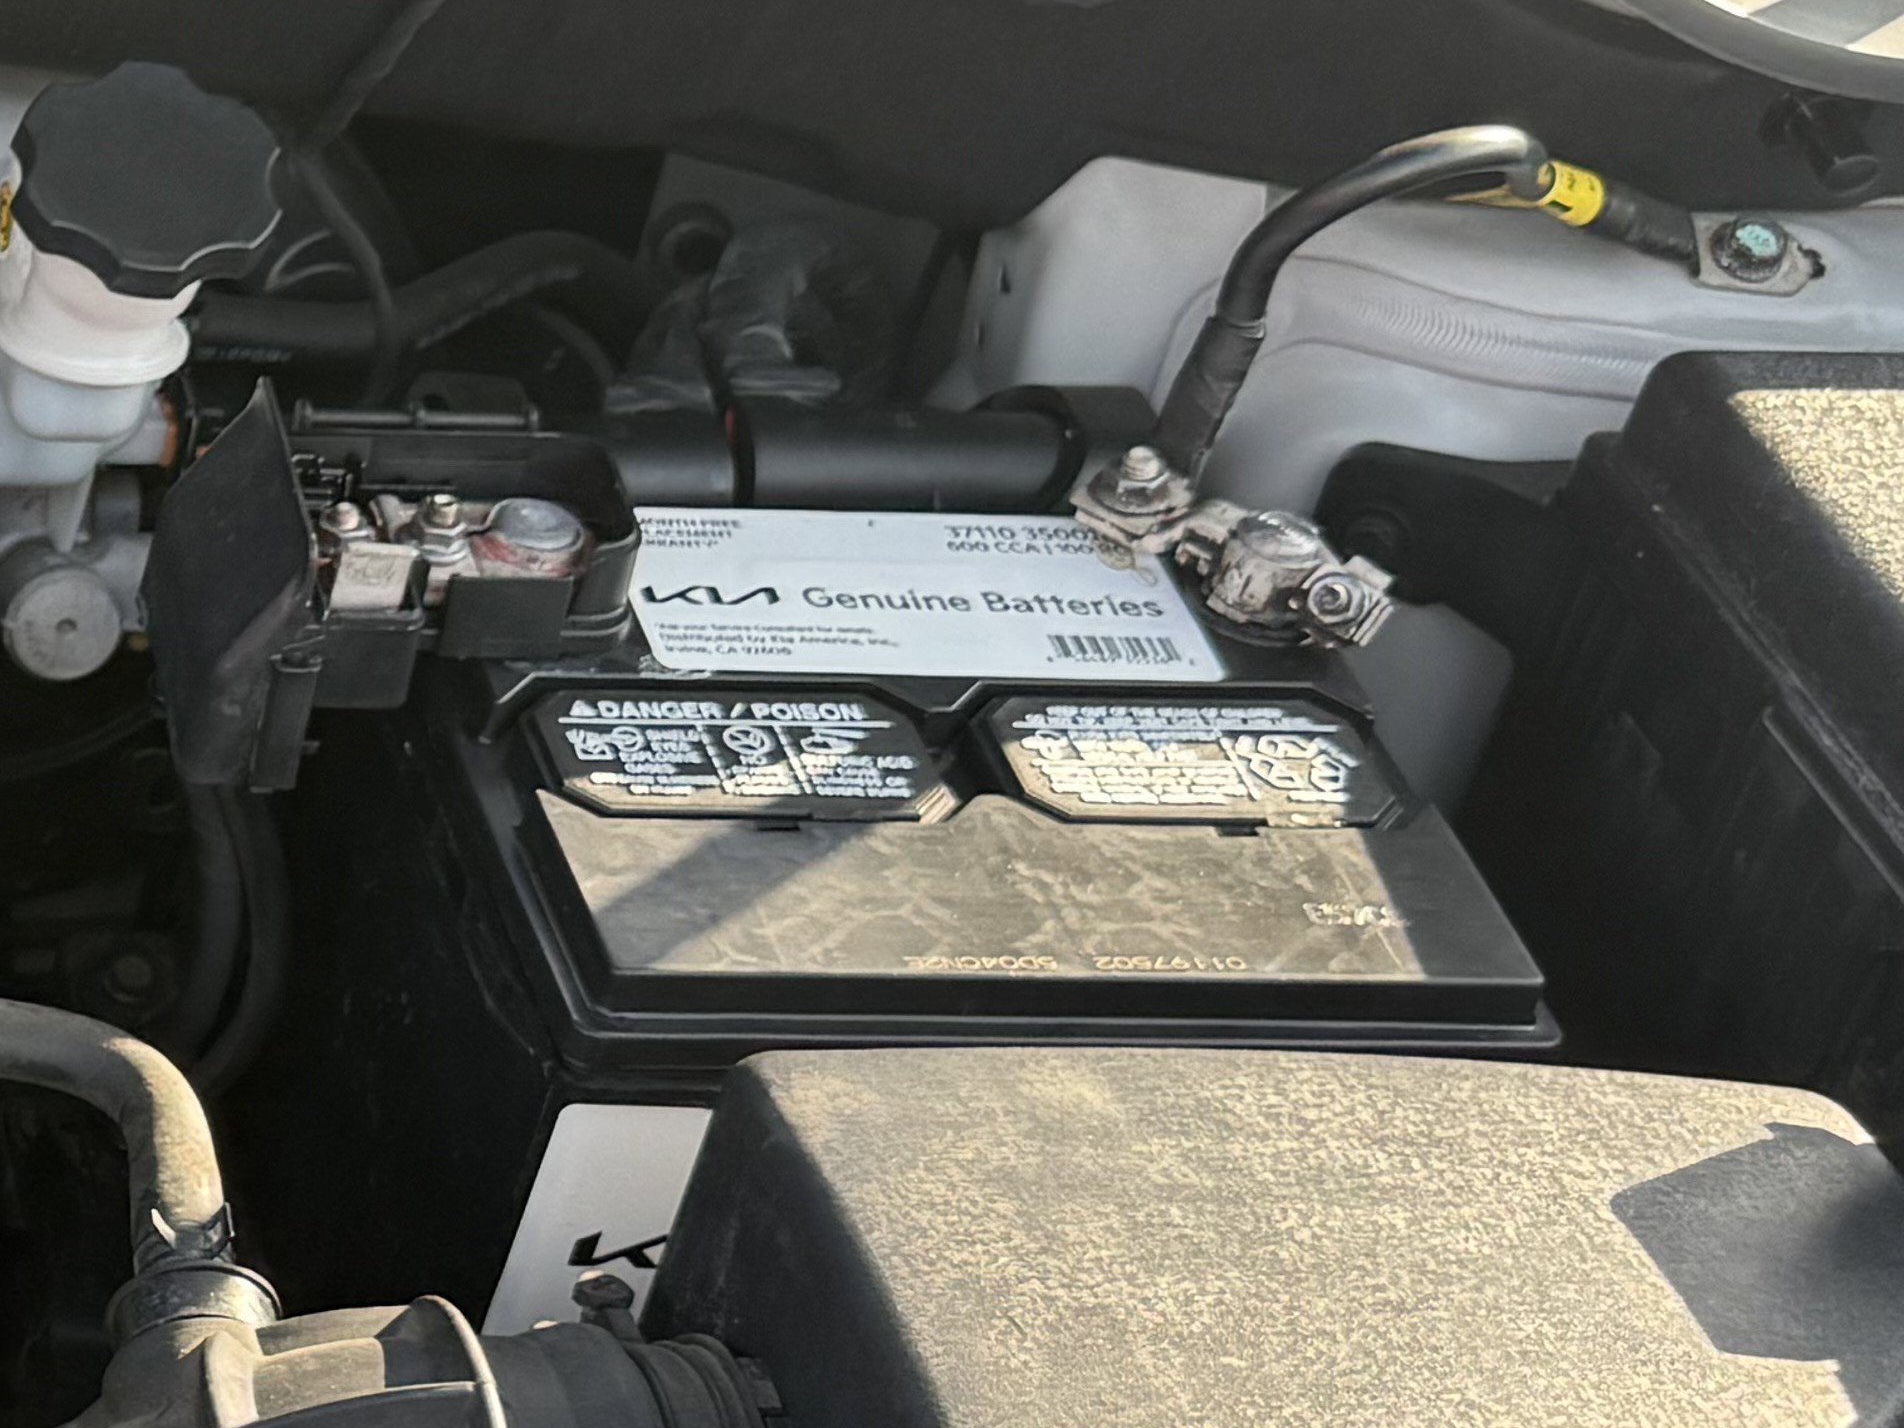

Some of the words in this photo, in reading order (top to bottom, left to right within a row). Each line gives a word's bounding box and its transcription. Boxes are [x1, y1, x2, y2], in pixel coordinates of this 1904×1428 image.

[993, 540, 1041, 555] CCA
[639, 584, 781, 606] KIA
[801, 585, 972, 612] Genuine
[979, 590, 1165, 618] Batteries
[597, 699, 724, 719] DANGER
[749, 702, 869, 721] POISON
